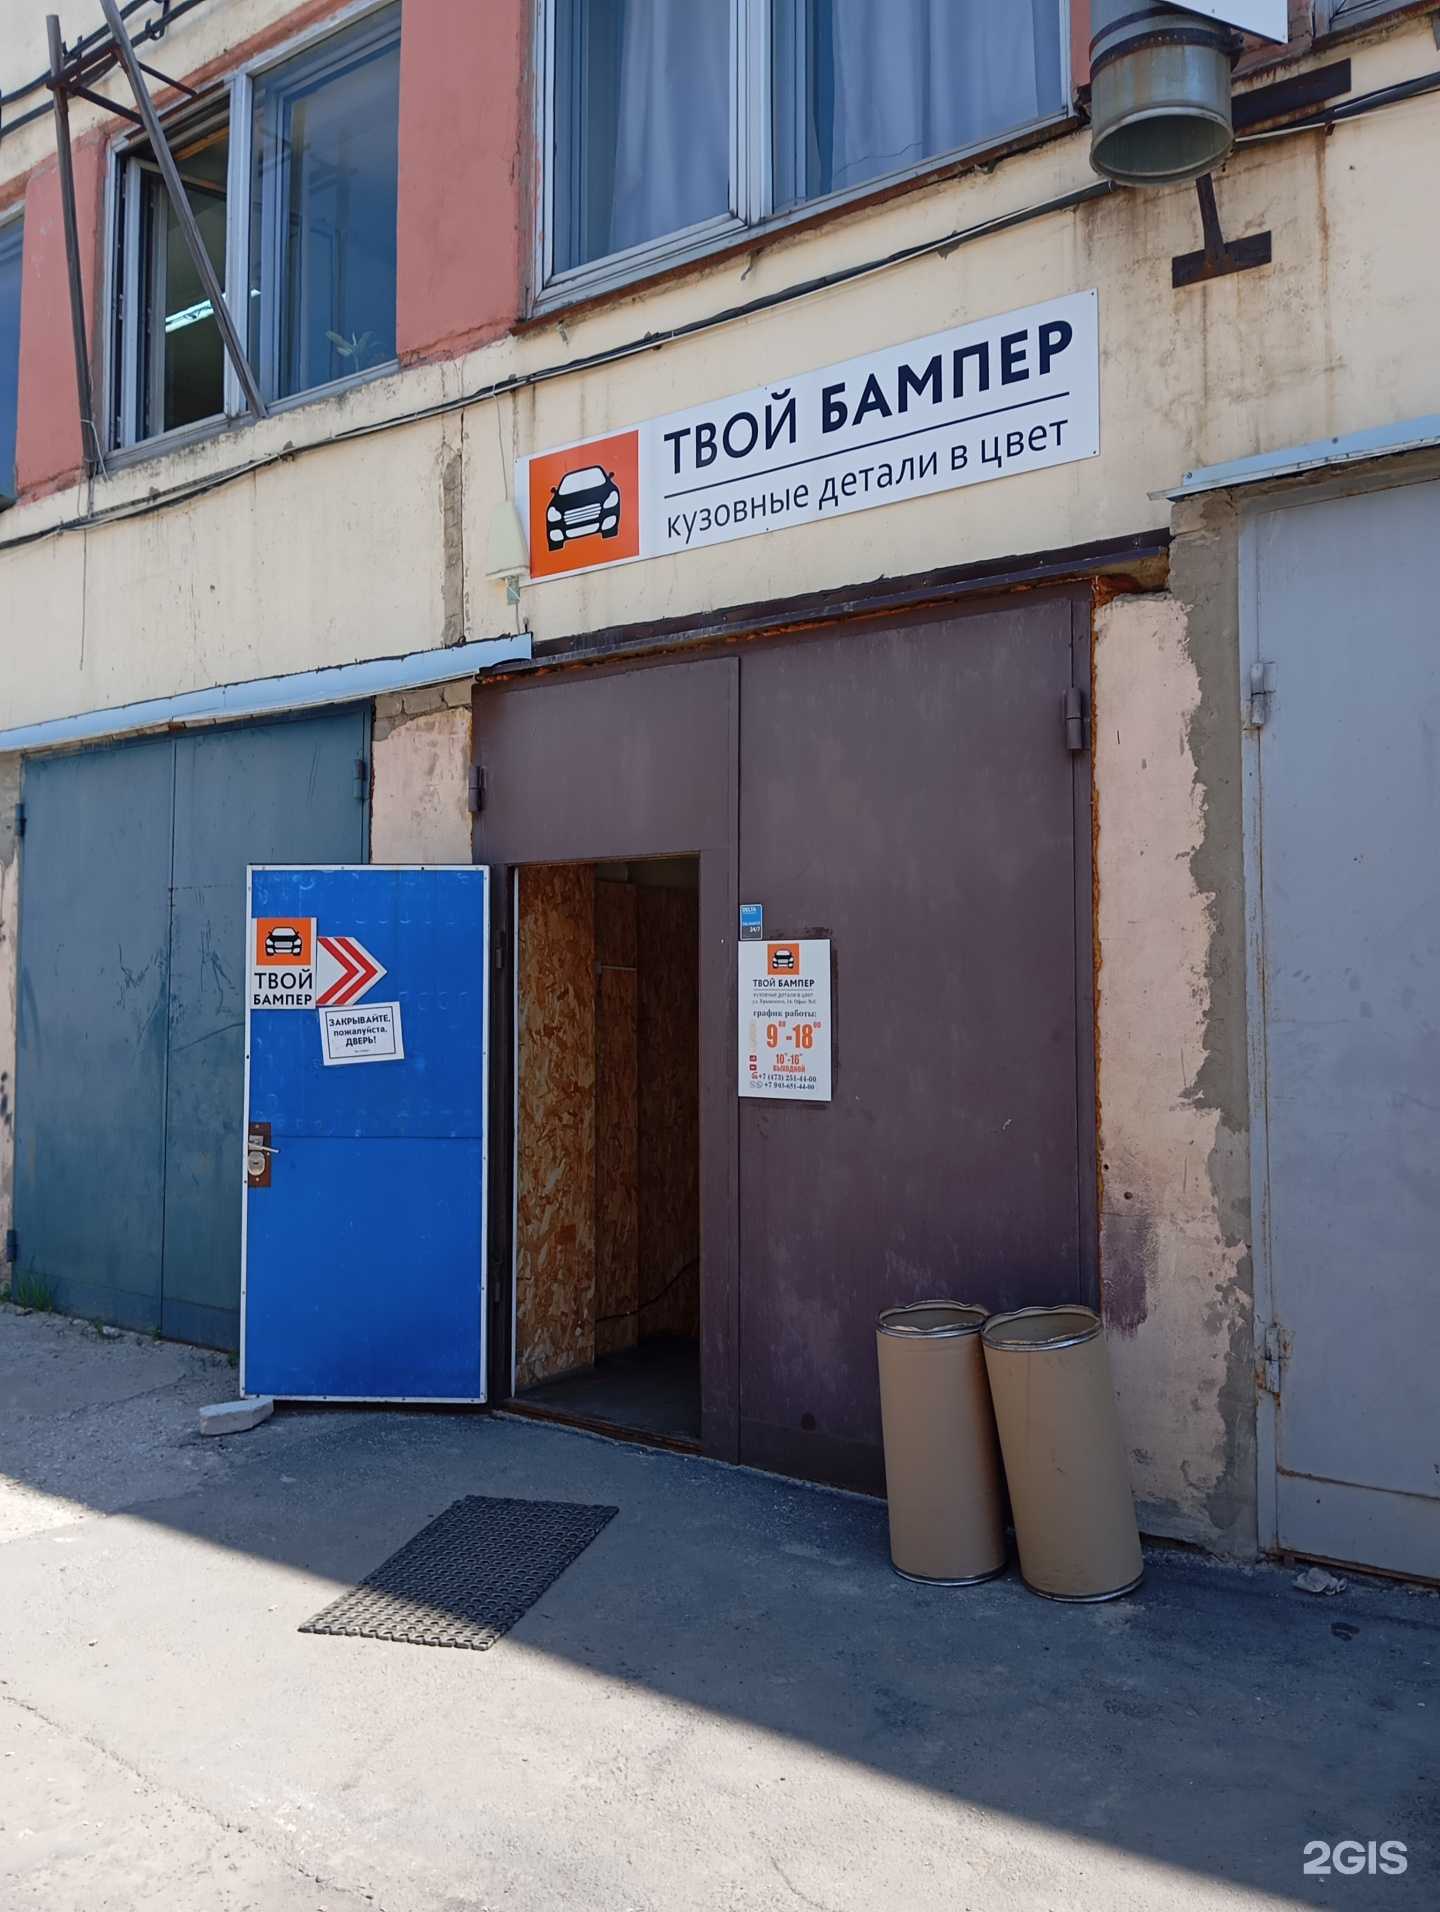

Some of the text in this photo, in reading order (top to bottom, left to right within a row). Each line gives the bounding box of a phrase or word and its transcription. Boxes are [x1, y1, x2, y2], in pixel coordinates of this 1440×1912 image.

[664, 320, 1073, 474] ТВОЙ БАМПЕР
[666, 418, 1069, 544] кузовные детали в цвет
[254, 969, 313, 990] ТВОЙ
[752, 977, 815, 987] ТВОЙ БАМПЕР
[253, 994, 313, 1006] БАМПЕР
[753, 1008, 817, 1019] график работы:
[345, 1036, 377, 1047] ДВЕРЬ!
